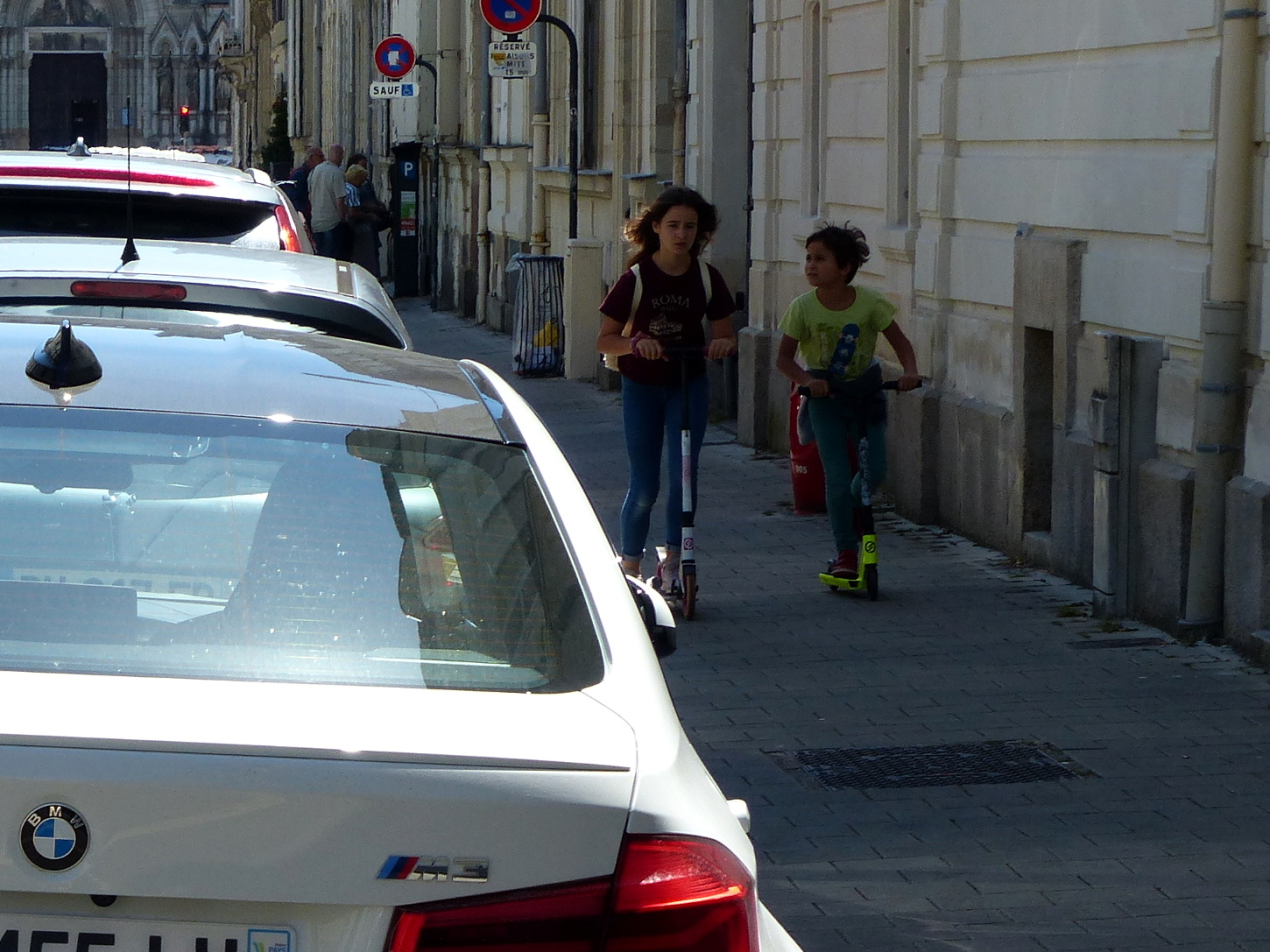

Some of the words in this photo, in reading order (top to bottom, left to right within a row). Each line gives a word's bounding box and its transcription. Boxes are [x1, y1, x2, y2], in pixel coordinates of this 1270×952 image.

[493, 42, 531, 51] RÉSERVÉ
[373, 86, 400, 95] SAUF
[404, 162, 413, 176] P
[651, 294, 690, 309] ROMA
[27, 806, 85, 829] BMW
[404, 856, 489, 882] M3
